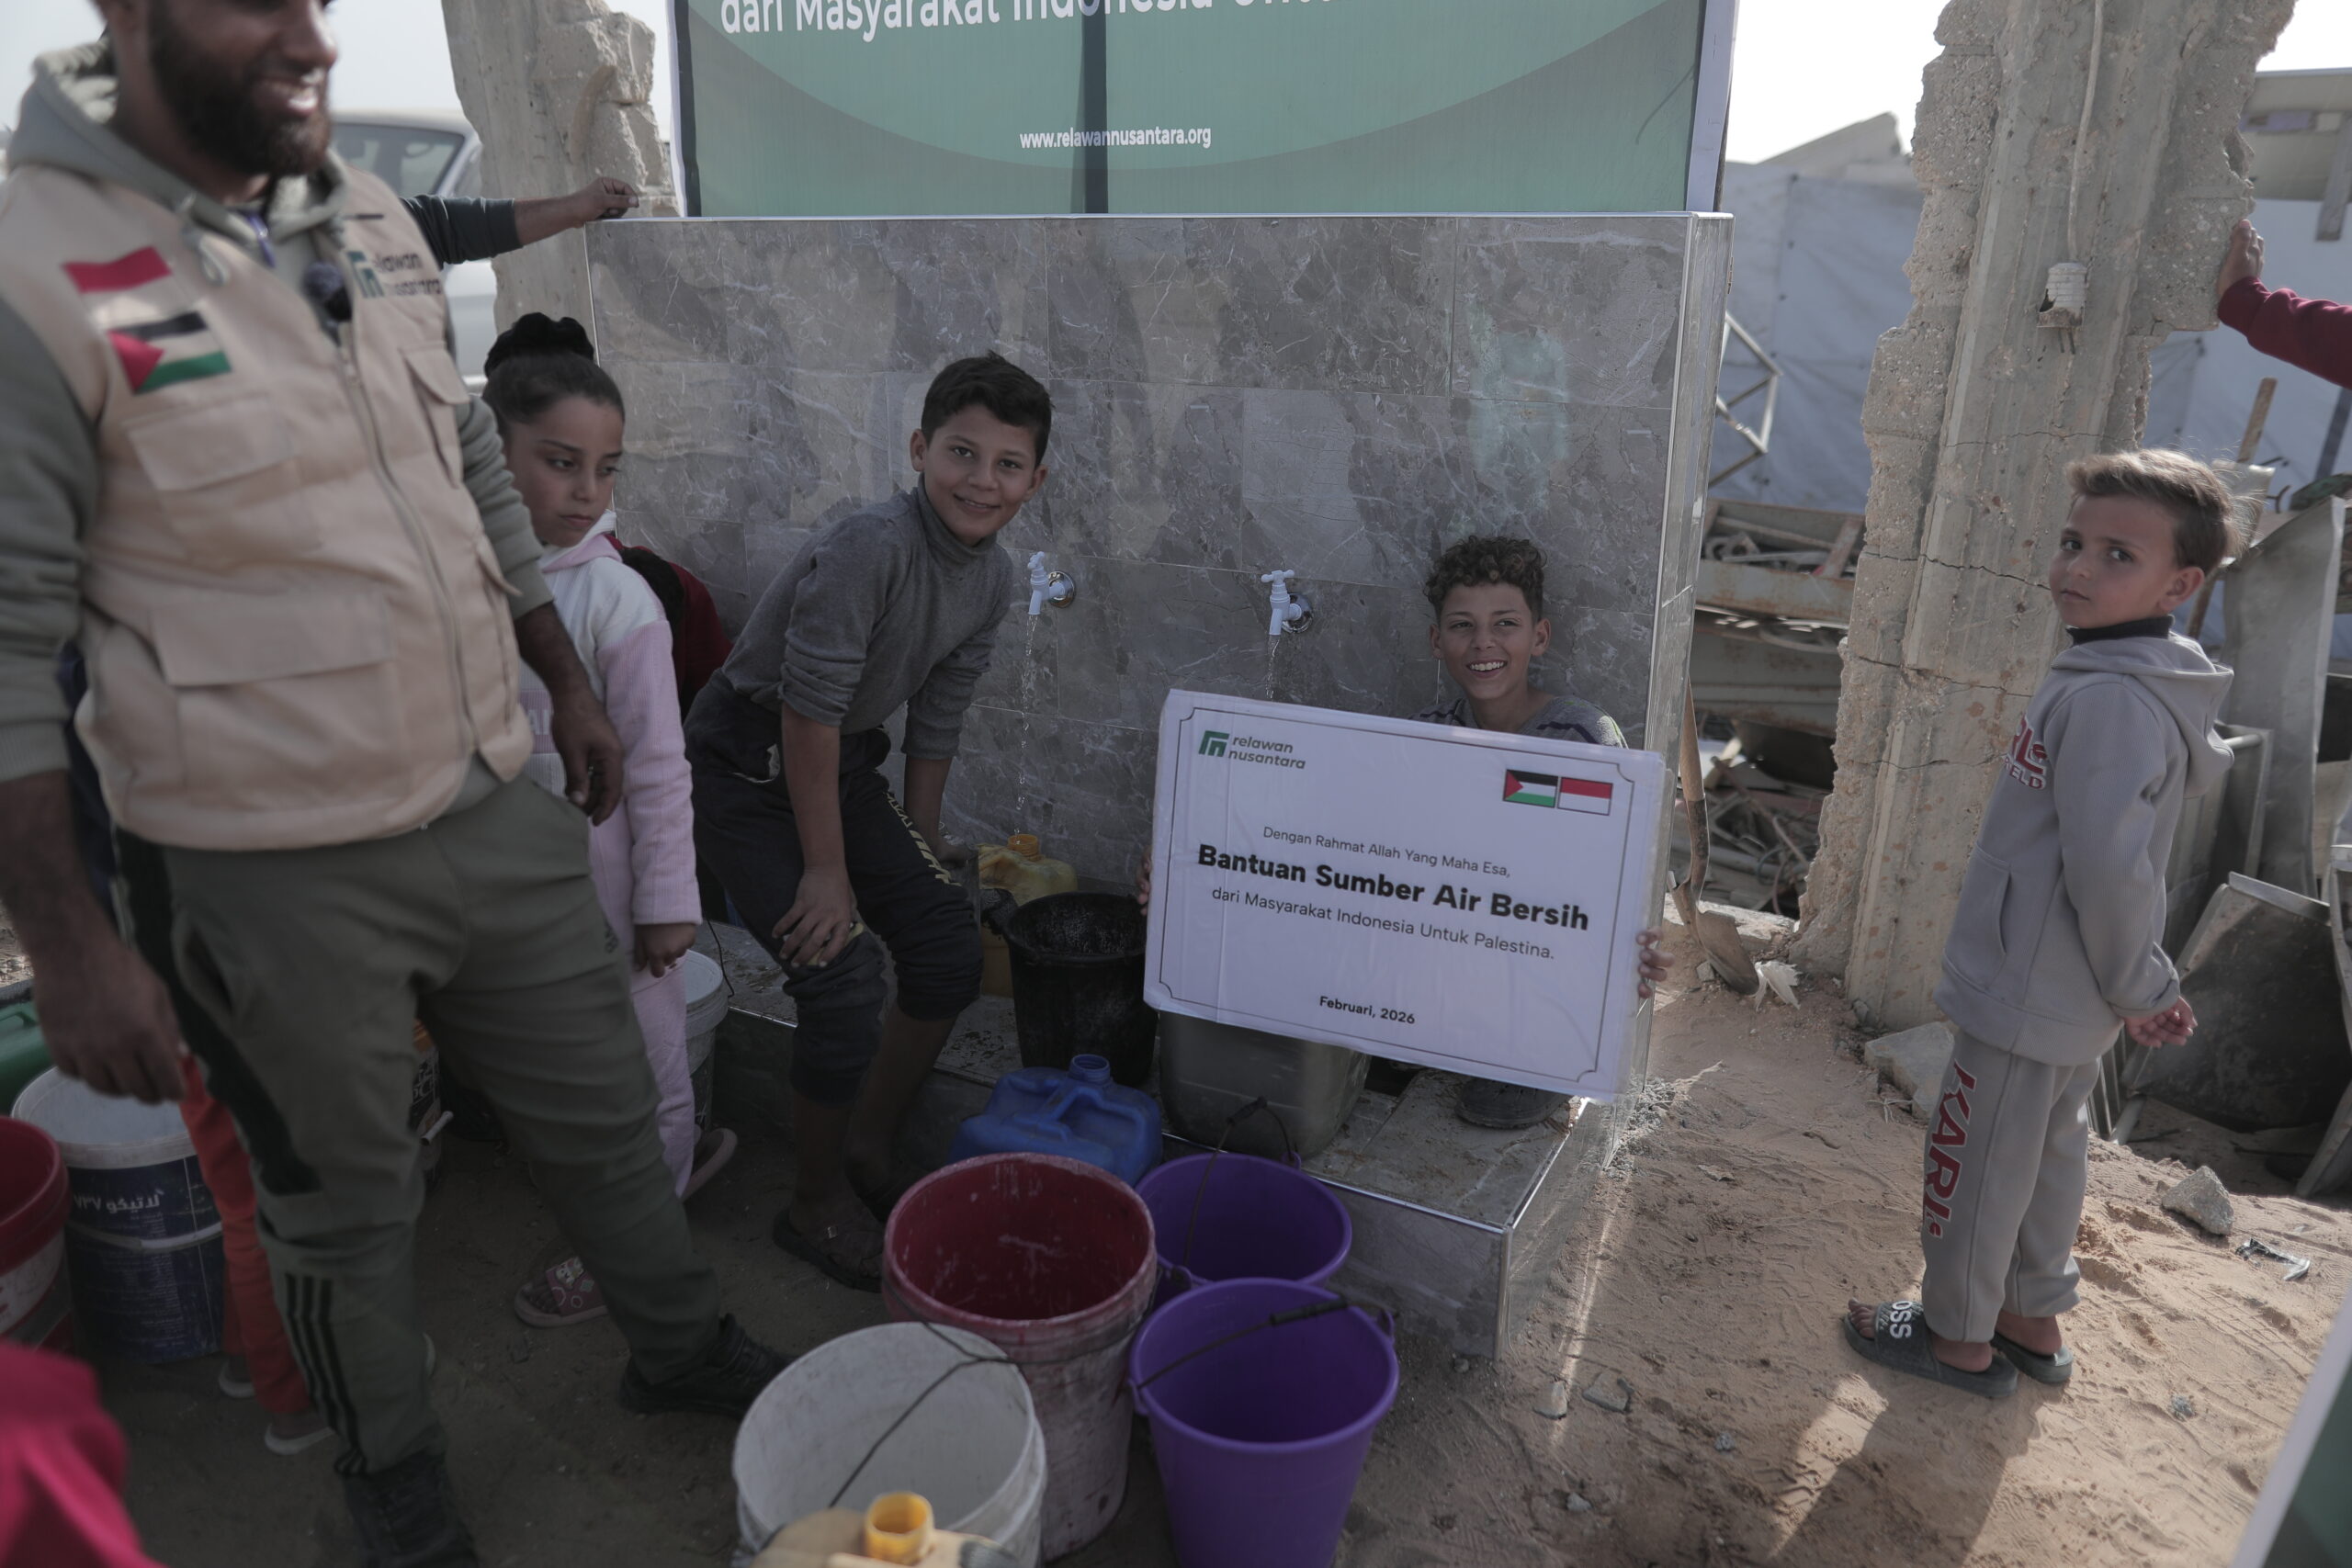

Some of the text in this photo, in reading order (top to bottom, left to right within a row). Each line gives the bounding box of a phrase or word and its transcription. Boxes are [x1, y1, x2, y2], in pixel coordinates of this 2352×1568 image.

[1020, 127, 1211, 149] www.relawannusantara.org
[1232, 737, 1293, 753] relawan
[1227, 750, 1306, 769] nusantara
[1263, 827, 1510, 877] Dengan Rahmat Allah Yang Maha Esa,
[1197, 843, 1589, 931] Bantuan Sumber Air Bersih
[1212, 886, 1554, 959] dari Masyarakat Indonesia Untuk Palestina.
[1319, 996, 1415, 1024] Februari, 2026
